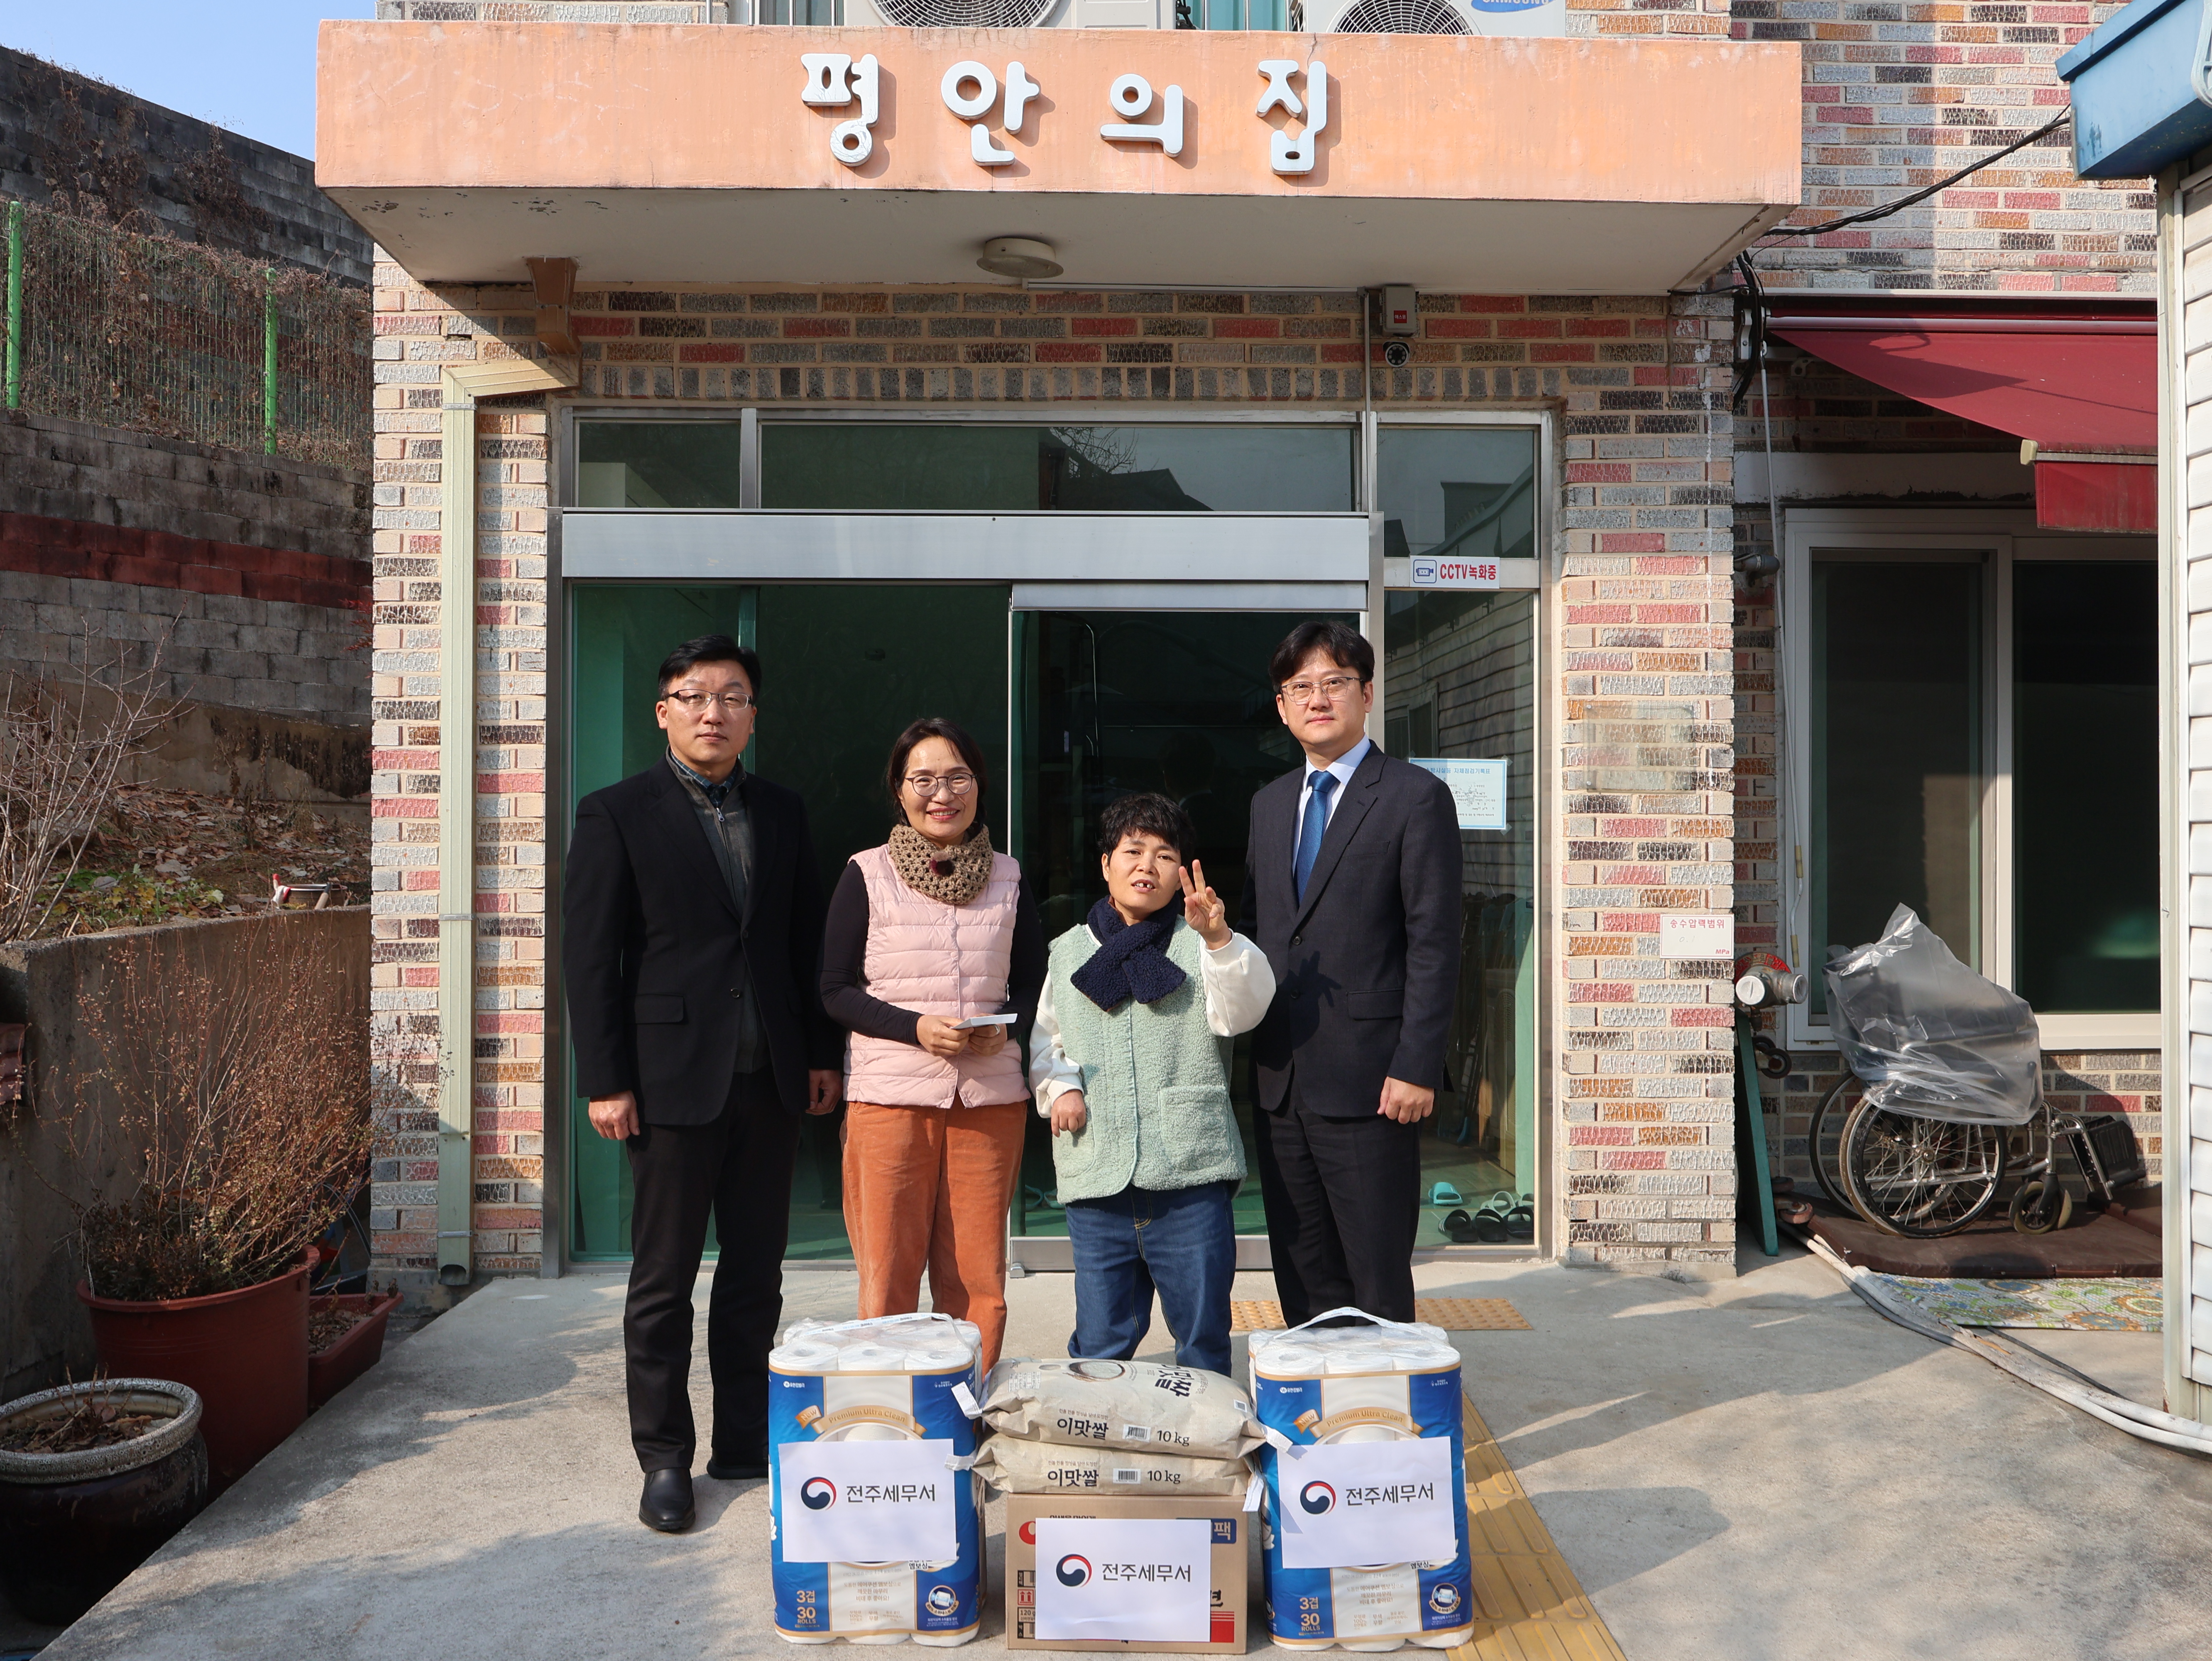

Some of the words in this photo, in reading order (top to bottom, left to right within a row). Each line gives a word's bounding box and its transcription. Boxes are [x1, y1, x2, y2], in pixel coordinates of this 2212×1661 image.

[1440, 563, 1497, 580] CCTV녹화중
[1670, 919, 1725, 929] 송수압력범위
[800, 1409, 817, 1422] New
[829, 1409, 862, 1423] Premium
[885, 1411, 906, 1423] Clean
[1299, 1413, 1315, 1426] New
[1327, 1411, 1360, 1427] Premium
[1382, 1411, 1404, 1423] Clean
[1057, 1417, 1109, 1441] 이맛쌀
[1157, 1429, 1171, 1442] 10
[1174, 1430, 1190, 1447] kg
[1047, 1469, 1099, 1487] 이맛쌀
[1147, 1470, 1161, 1482] 10
[1165, 1470, 1181, 1485] kg
[846, 1483, 935, 1504] 전주세무서
[1346, 1482, 1434, 1507] 전주세무서
[1101, 1563, 1192, 1583] 전주세무서
[796, 1590, 815, 1603] 3겹
[1299, 1597, 1319, 1610] 3겹
[797, 1606, 816, 1619] 30
[1300, 1613, 1320, 1626] 30
